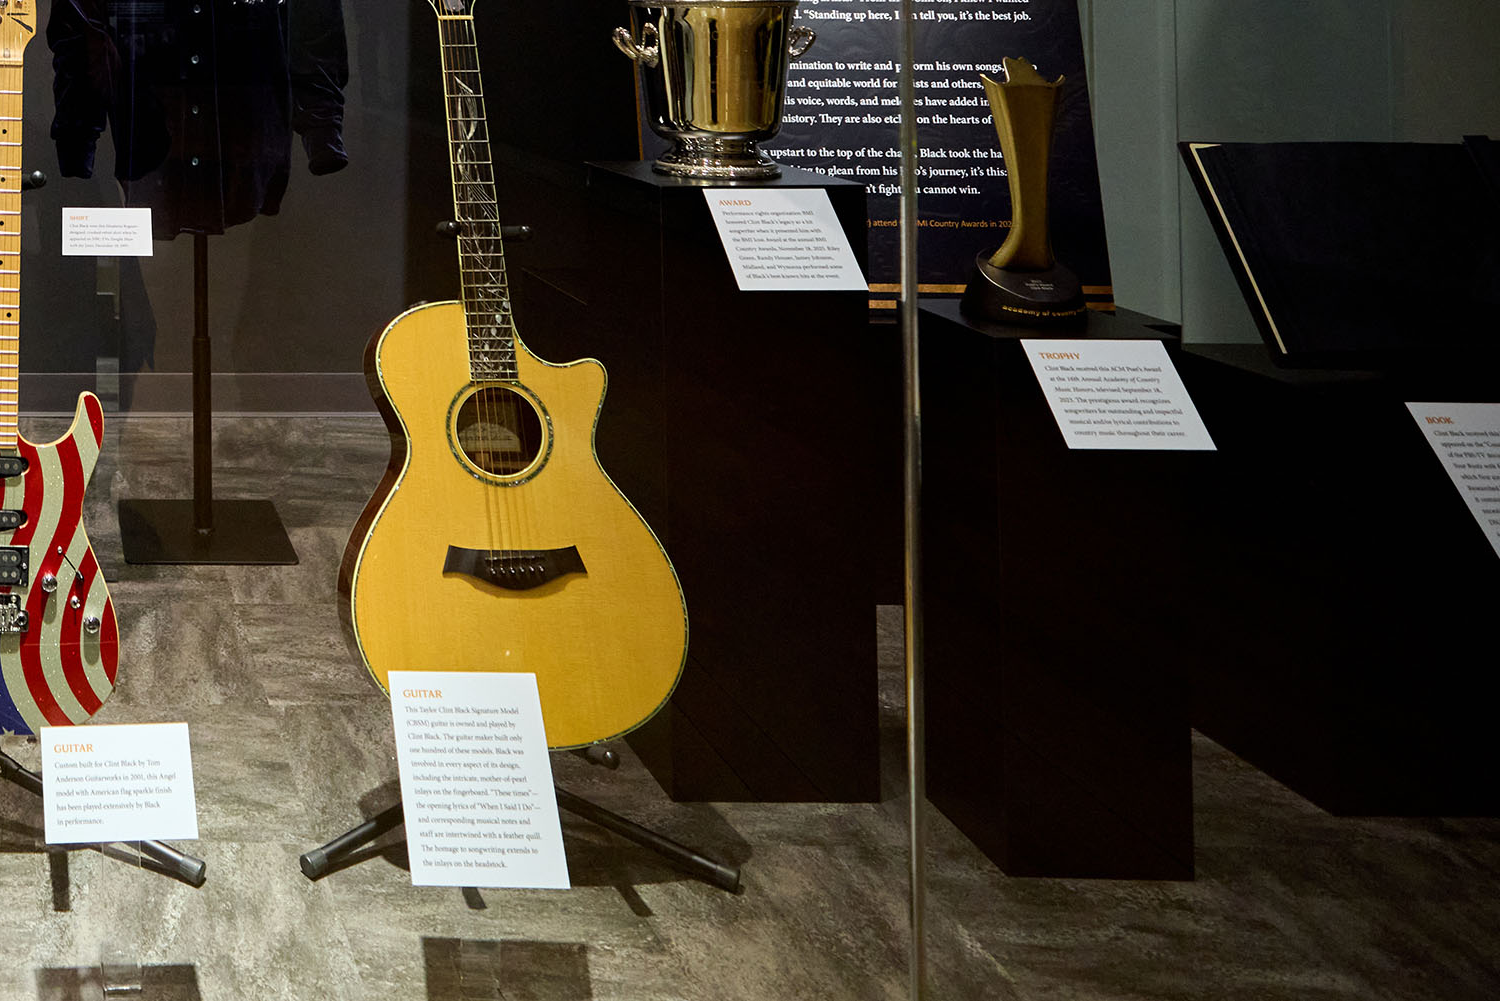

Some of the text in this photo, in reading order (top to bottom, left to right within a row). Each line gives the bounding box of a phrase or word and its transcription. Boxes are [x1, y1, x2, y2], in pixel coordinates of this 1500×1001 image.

[1038, 351, 1080, 360] TROPHY
[1425, 416, 1455, 425] BOOK
[402, 689, 443, 698] GUITAR
[53, 743, 94, 753] GUITAR
